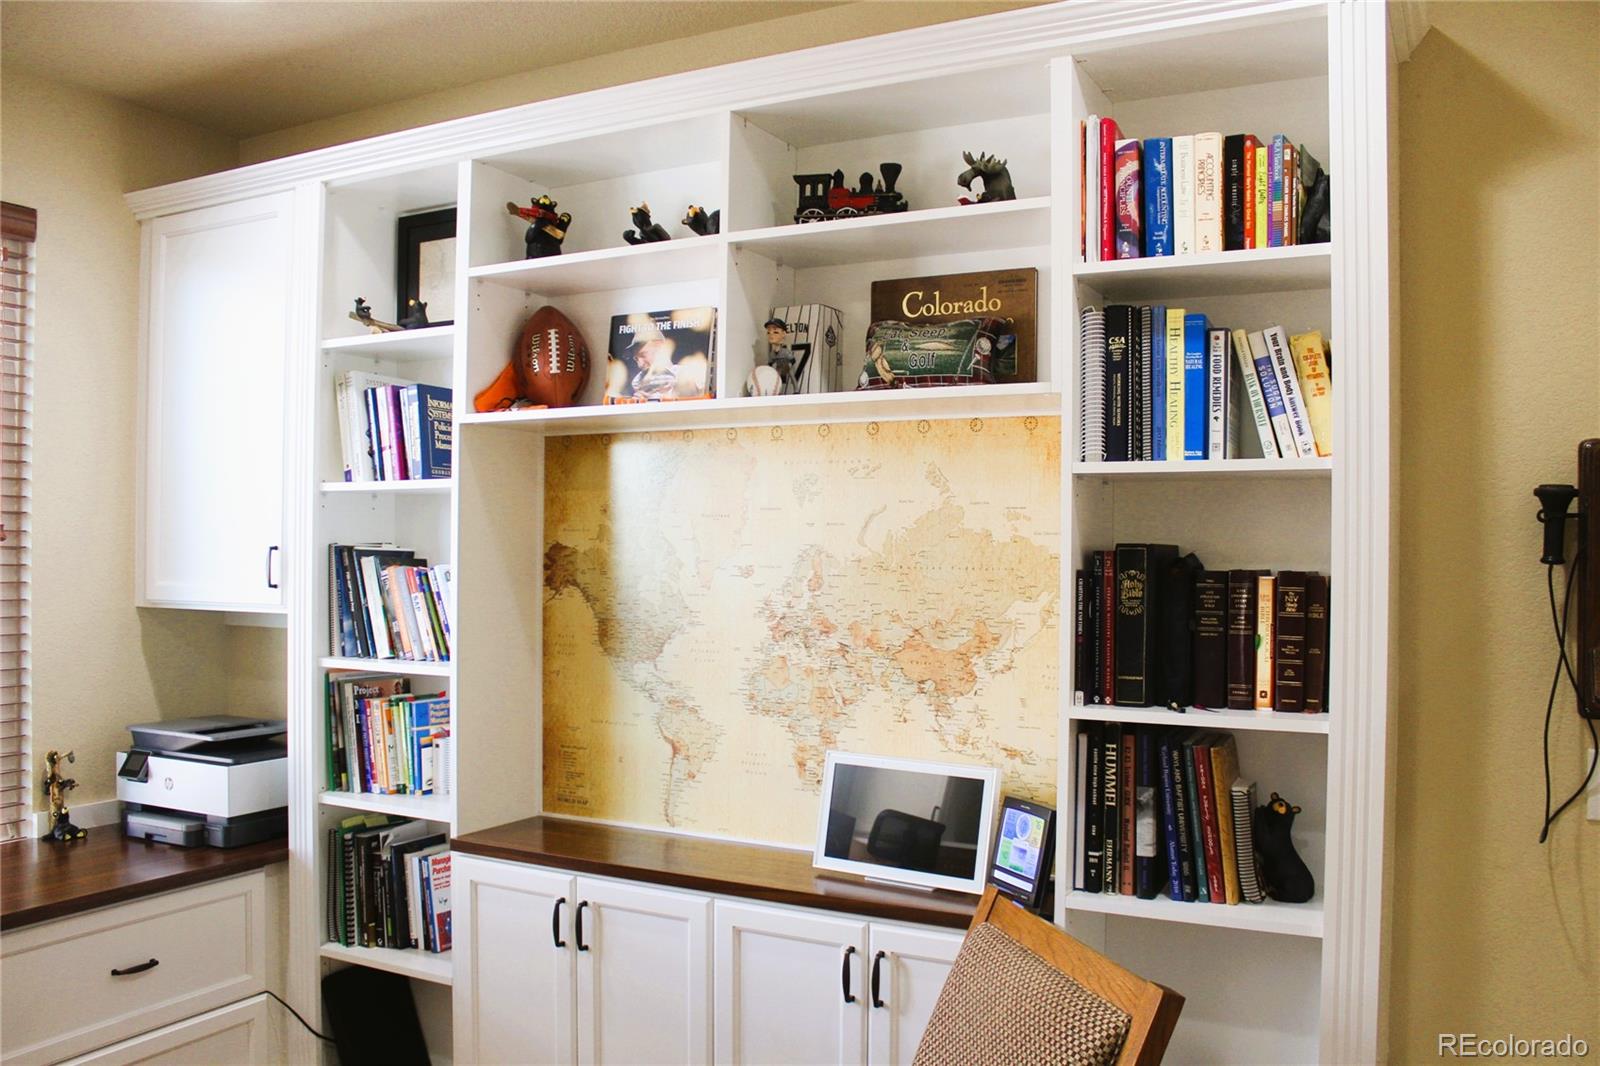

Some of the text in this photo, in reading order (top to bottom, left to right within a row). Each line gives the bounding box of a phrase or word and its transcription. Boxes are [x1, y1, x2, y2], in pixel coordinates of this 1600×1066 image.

[1206, 152, 1214, 201] ACCOUNTING
[1274, 153, 1282, 181] Handbook
[902, 286, 1001, 318] Colorado
[656, 320, 672, 331] THE
[785, 323, 808, 333] ELTON
[1109, 336, 1125, 344] CSA
[902, 340, 909, 352] &
[909, 352, 936, 369] Golf
[792, 343, 811, 381] 7
[1170, 327, 1181, 428] HEALTHY HEALING
[1213, 354, 1222, 413] FOOD REMEDIES
[1258, 365, 1275, 409] SOLUTION
[1270, 332, 1305, 436] Your Brain and Body Answer Book
[1270, 379, 1282, 408] SUGAR
[1120, 589, 1143, 599] Bible
[1121, 579, 1143, 590] Holy
[354, 685, 380, 696] Project
[1105, 743, 1116, 809] HUMMEL
[1172, 750, 1181, 782] WAYLAND
[1175, 784, 1184, 811] BAPTIST
[1178, 813, 1188, 853] UNIVERSITY
